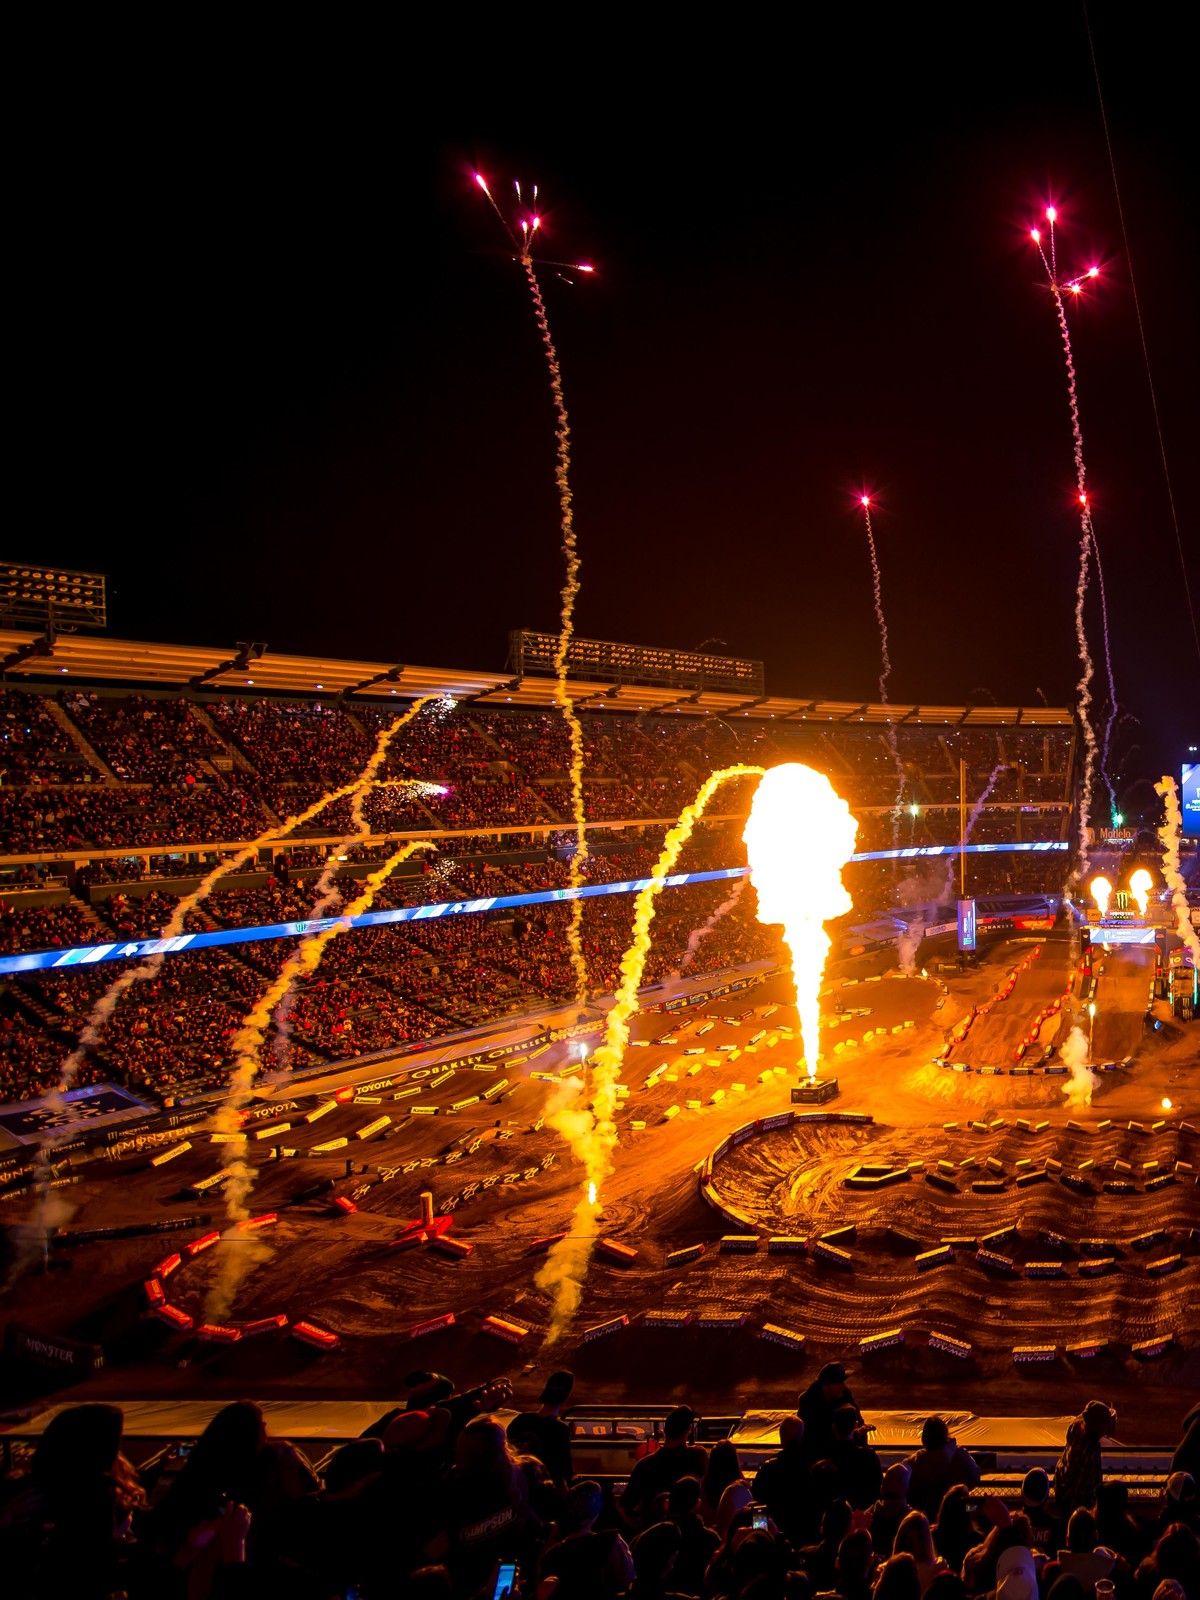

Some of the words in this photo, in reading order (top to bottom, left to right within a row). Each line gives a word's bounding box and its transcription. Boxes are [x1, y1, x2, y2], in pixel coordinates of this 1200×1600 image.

[505, 1036, 547, 1054] OAKLEY
[432, 1056, 482, 1074] OAKLEY
[356, 1080, 393, 1095] TOYOTA
[253, 1101, 298, 1118] TOYOTA
[122, 1126, 195, 1149] MONSTER
[419, 1321, 446, 1336] HONDA
[490, 1327, 520, 1344] HONDA
[26, 1337, 74, 1364] MONSTER
